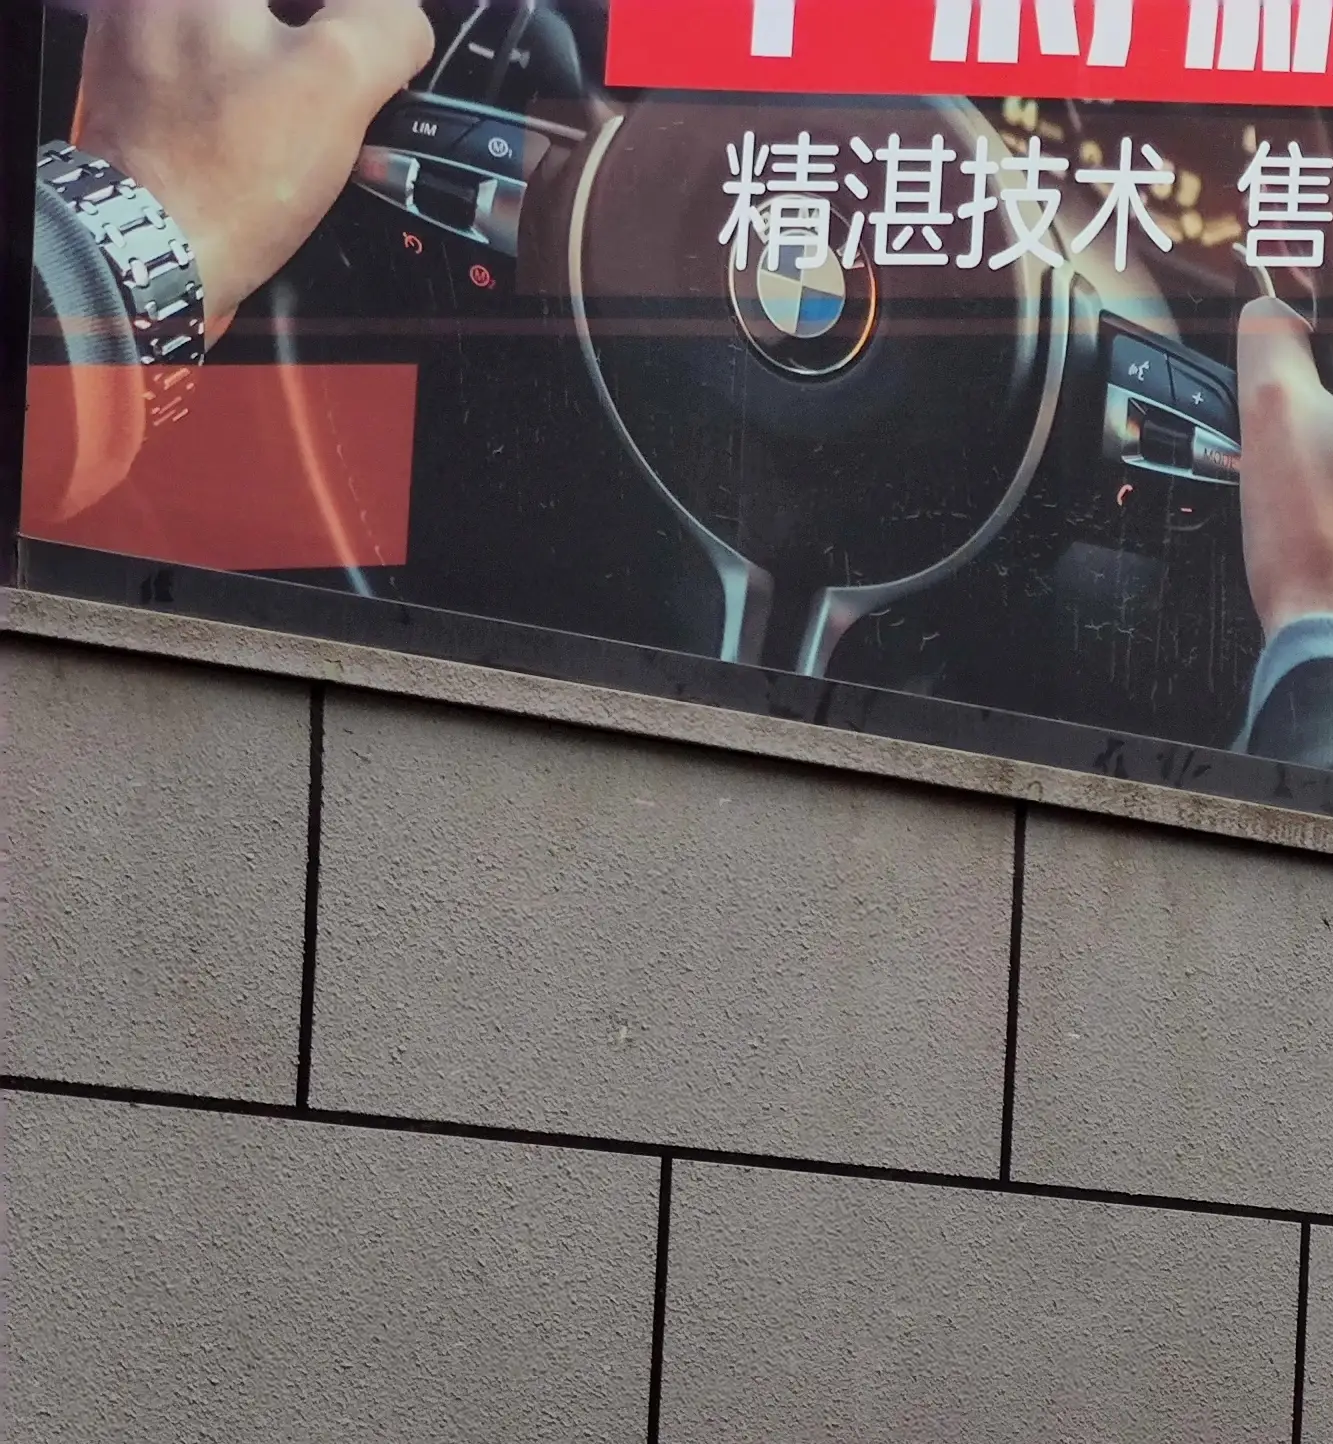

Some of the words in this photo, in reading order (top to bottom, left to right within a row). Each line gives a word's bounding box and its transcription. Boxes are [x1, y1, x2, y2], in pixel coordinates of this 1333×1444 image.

[412, 120, 437, 137] LIM
[718, 131, 1175, 272] 精湛技术
